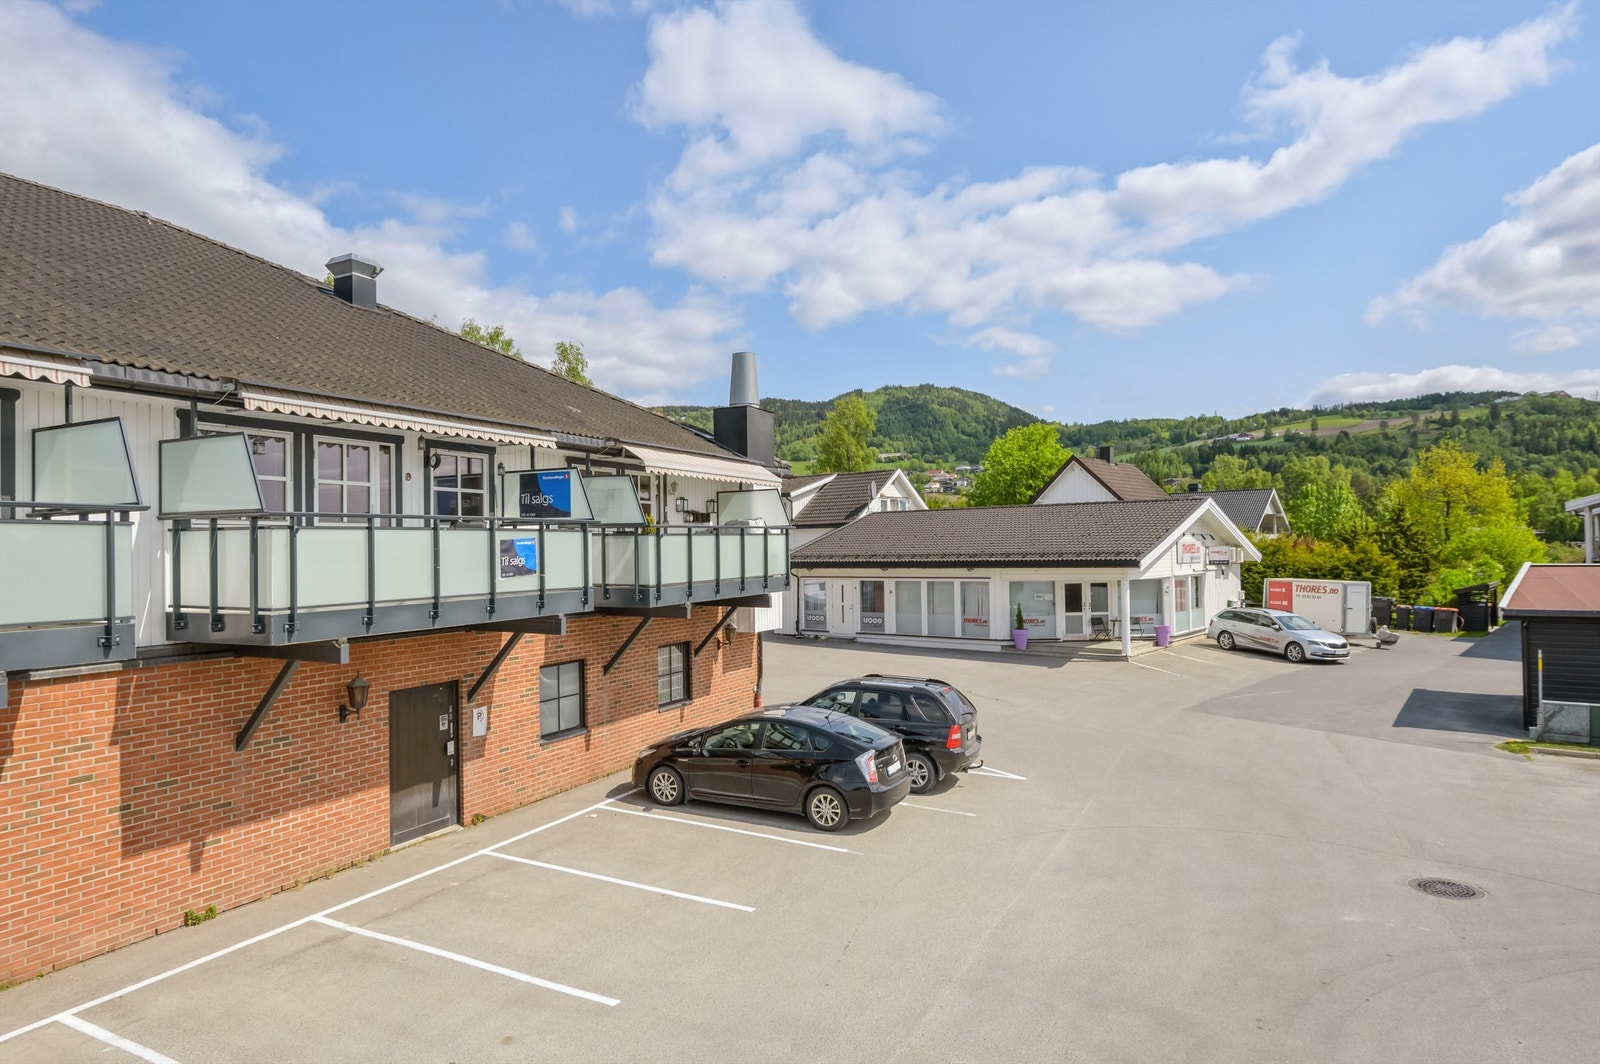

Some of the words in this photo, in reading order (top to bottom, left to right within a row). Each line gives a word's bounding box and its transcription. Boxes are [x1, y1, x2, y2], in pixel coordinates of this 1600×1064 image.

[520, 493, 530, 504] Til
[531, 492, 554, 506] salgs
[501, 556, 509, 566] Til
[509, 555, 526, 567] salgs
[1295, 585, 1339, 595] THORES.no
